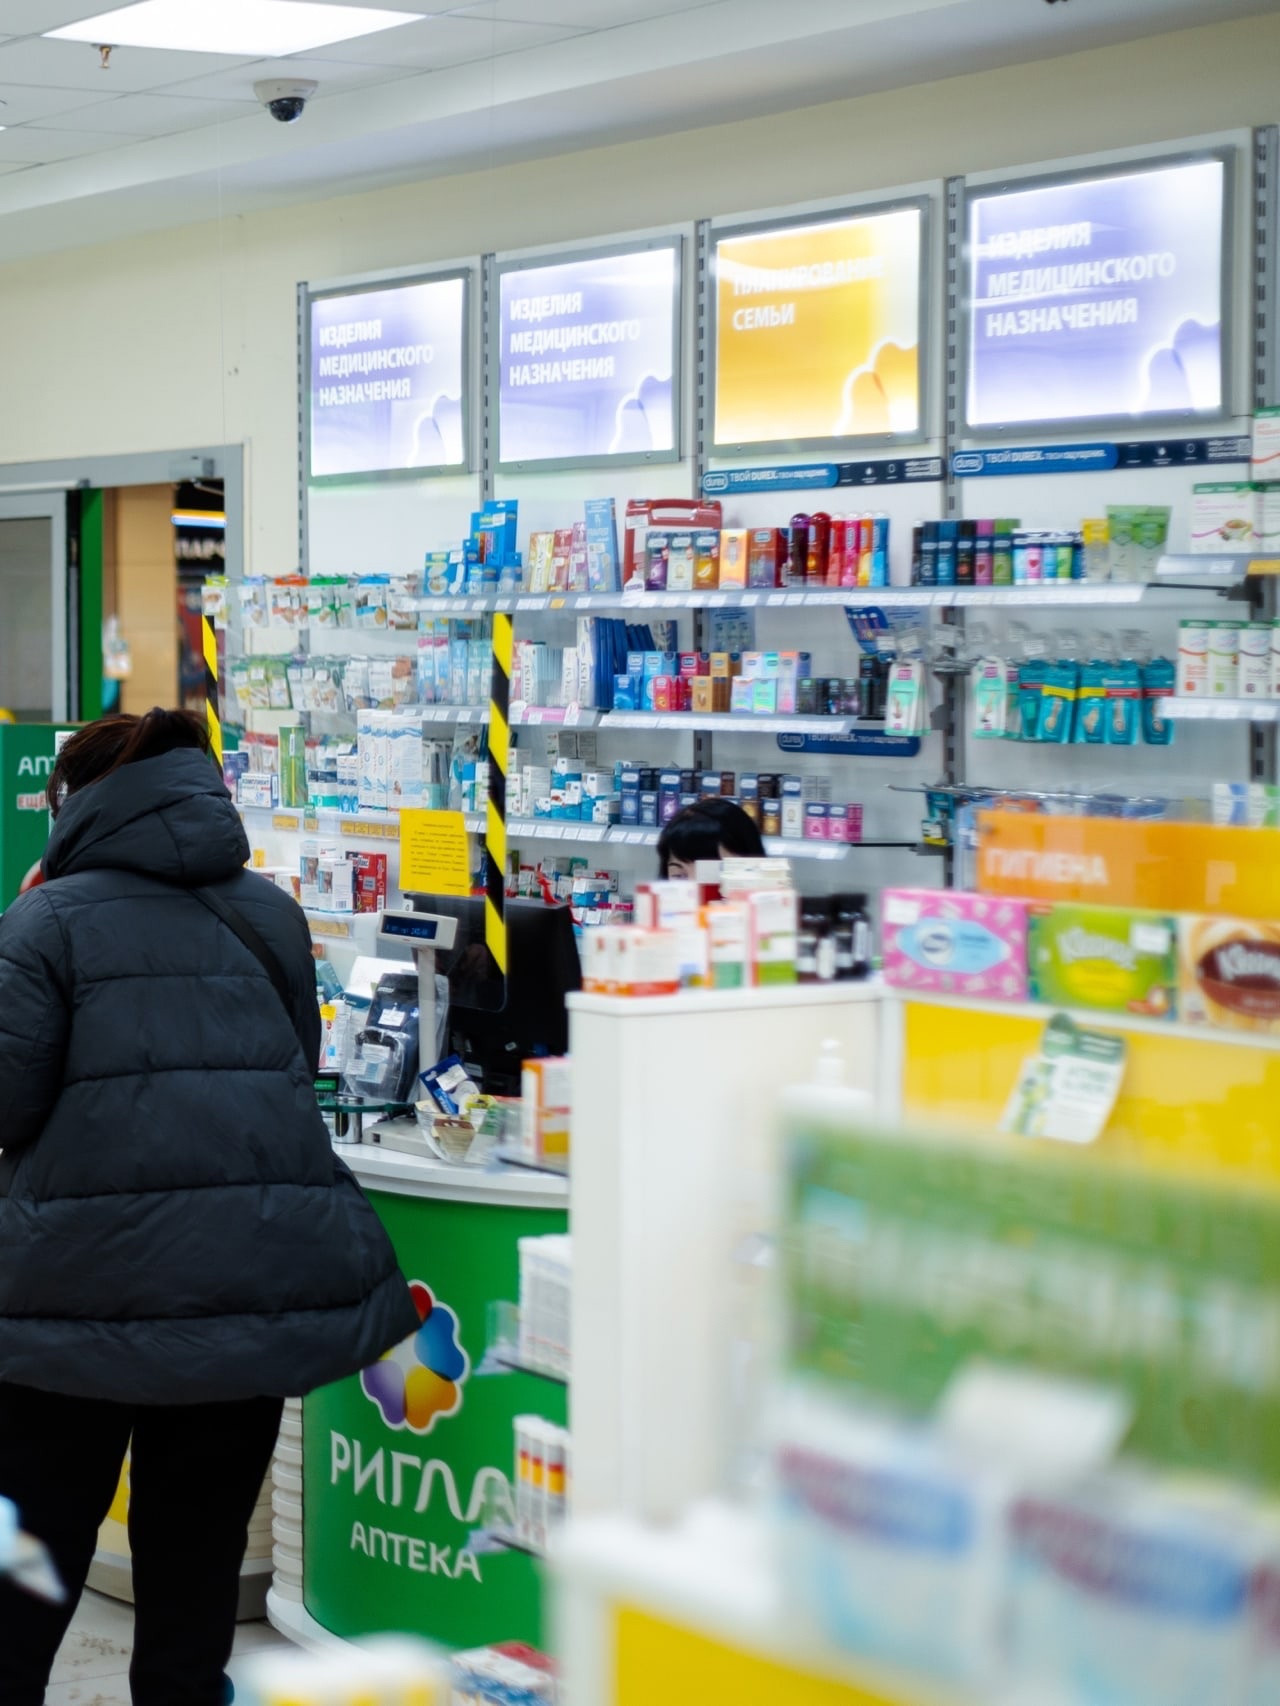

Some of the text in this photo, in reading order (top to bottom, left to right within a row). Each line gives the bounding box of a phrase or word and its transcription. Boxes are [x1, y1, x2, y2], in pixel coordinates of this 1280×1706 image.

[987, 221, 1091, 260] ИЗДЕЛИЯ
[987, 252, 1176, 297] МЕДИЦИНСКОГО
[510, 292, 582, 323] ИЗДЕЛИЯ
[733, 303, 795, 331] СЕМЬИ
[986, 298, 1138, 337] НАЗНАЧЕНИЯ
[320, 319, 382, 348] ИЗДЕЛИЯ
[510, 319, 640, 356] МЕДИЦИНСКОГО
[320, 344, 434, 378] МЕДИЦИНСКОГО
[510, 356, 615, 387] НАЗНАЧЕНИЯ
[320, 378, 411, 407] НАЗНАЧЕНИЯ
[987, 849, 1109, 885] ГИГИЕНА
[331, 1430, 517, 1525] РИГЛА
[351, 1520, 483, 1583] АПТЕКА
